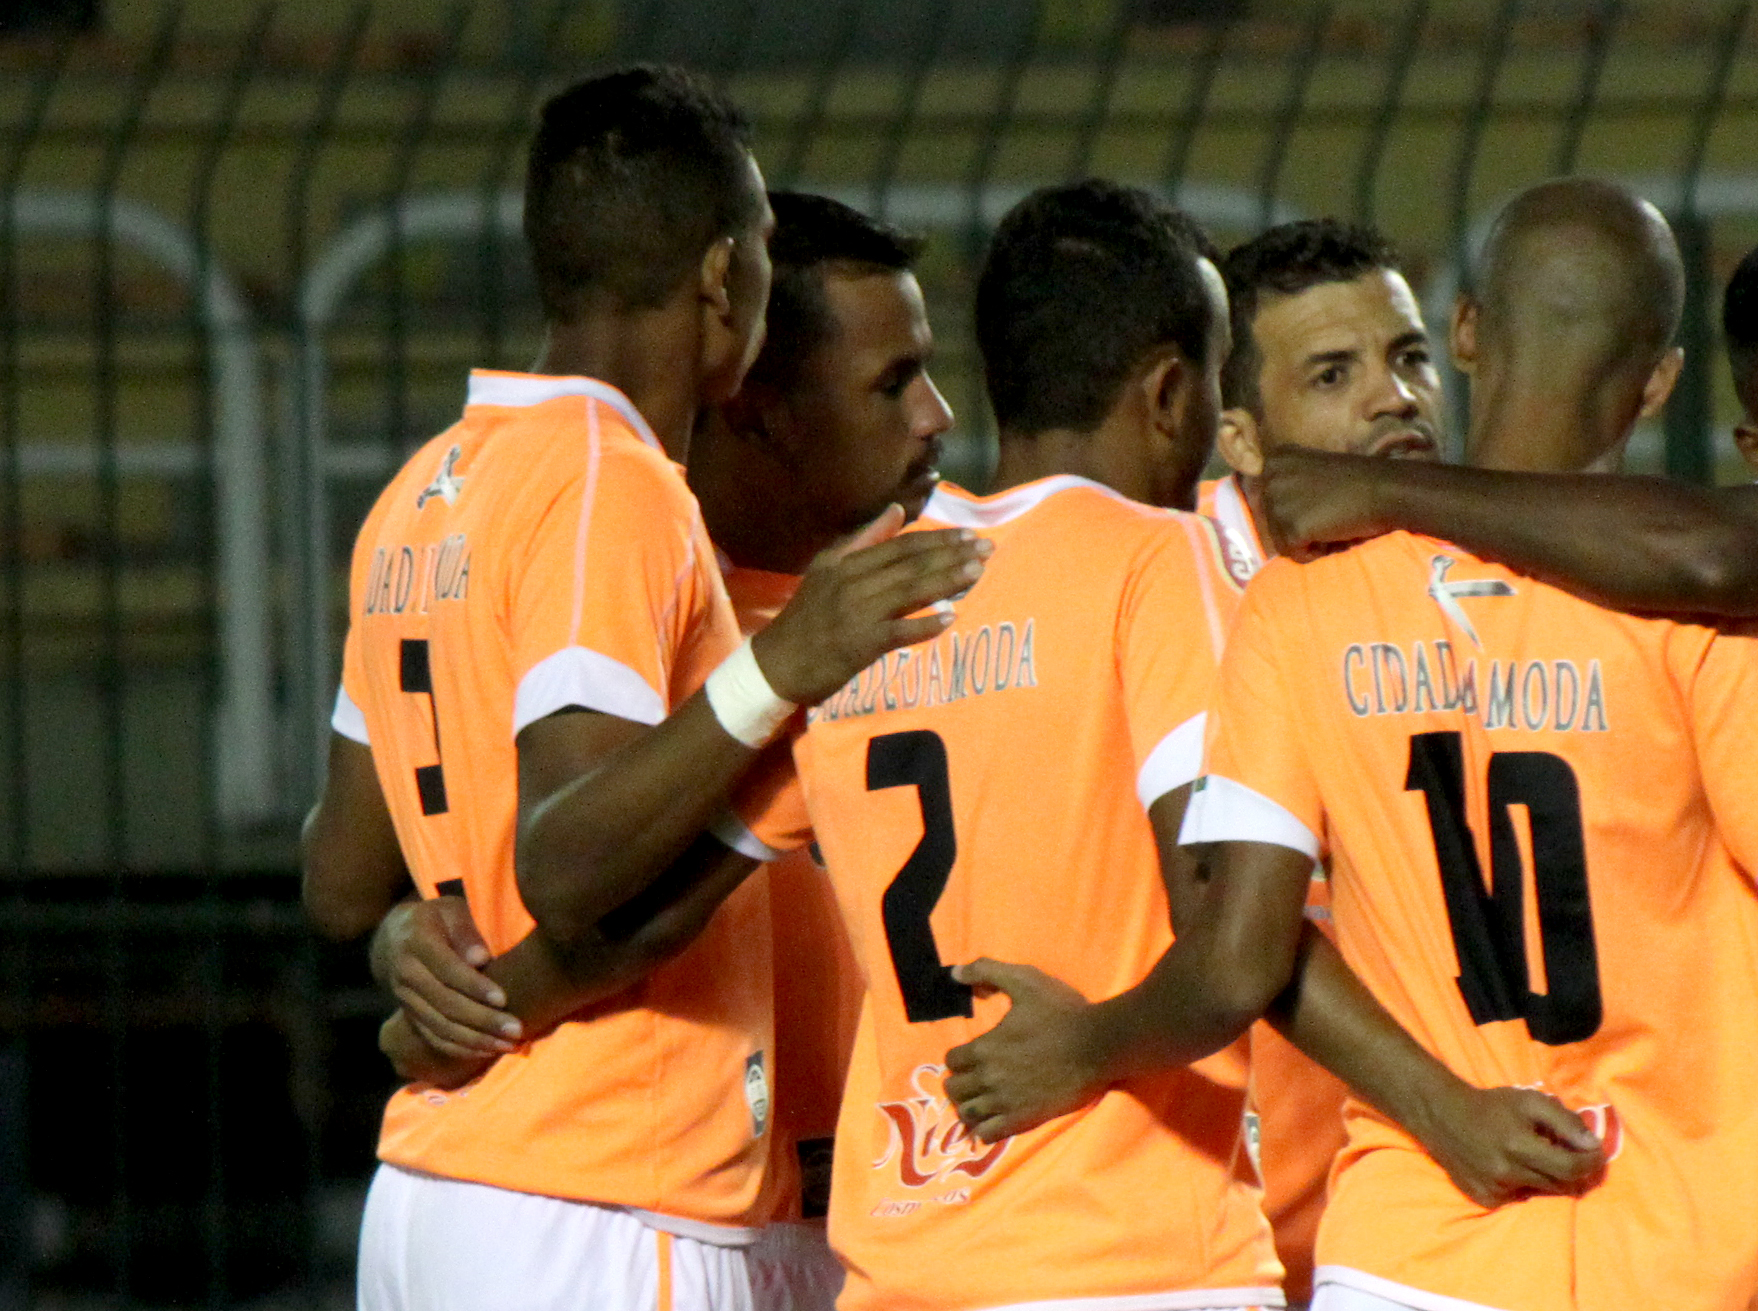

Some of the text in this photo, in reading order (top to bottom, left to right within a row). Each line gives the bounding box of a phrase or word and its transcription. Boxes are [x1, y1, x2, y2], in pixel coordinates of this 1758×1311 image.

[947, 618, 1038, 704] MODA
[1484, 657, 1609, 731] MODA
[866, 729, 974, 1023] 2
[1404, 730, 1604, 1046] 10
